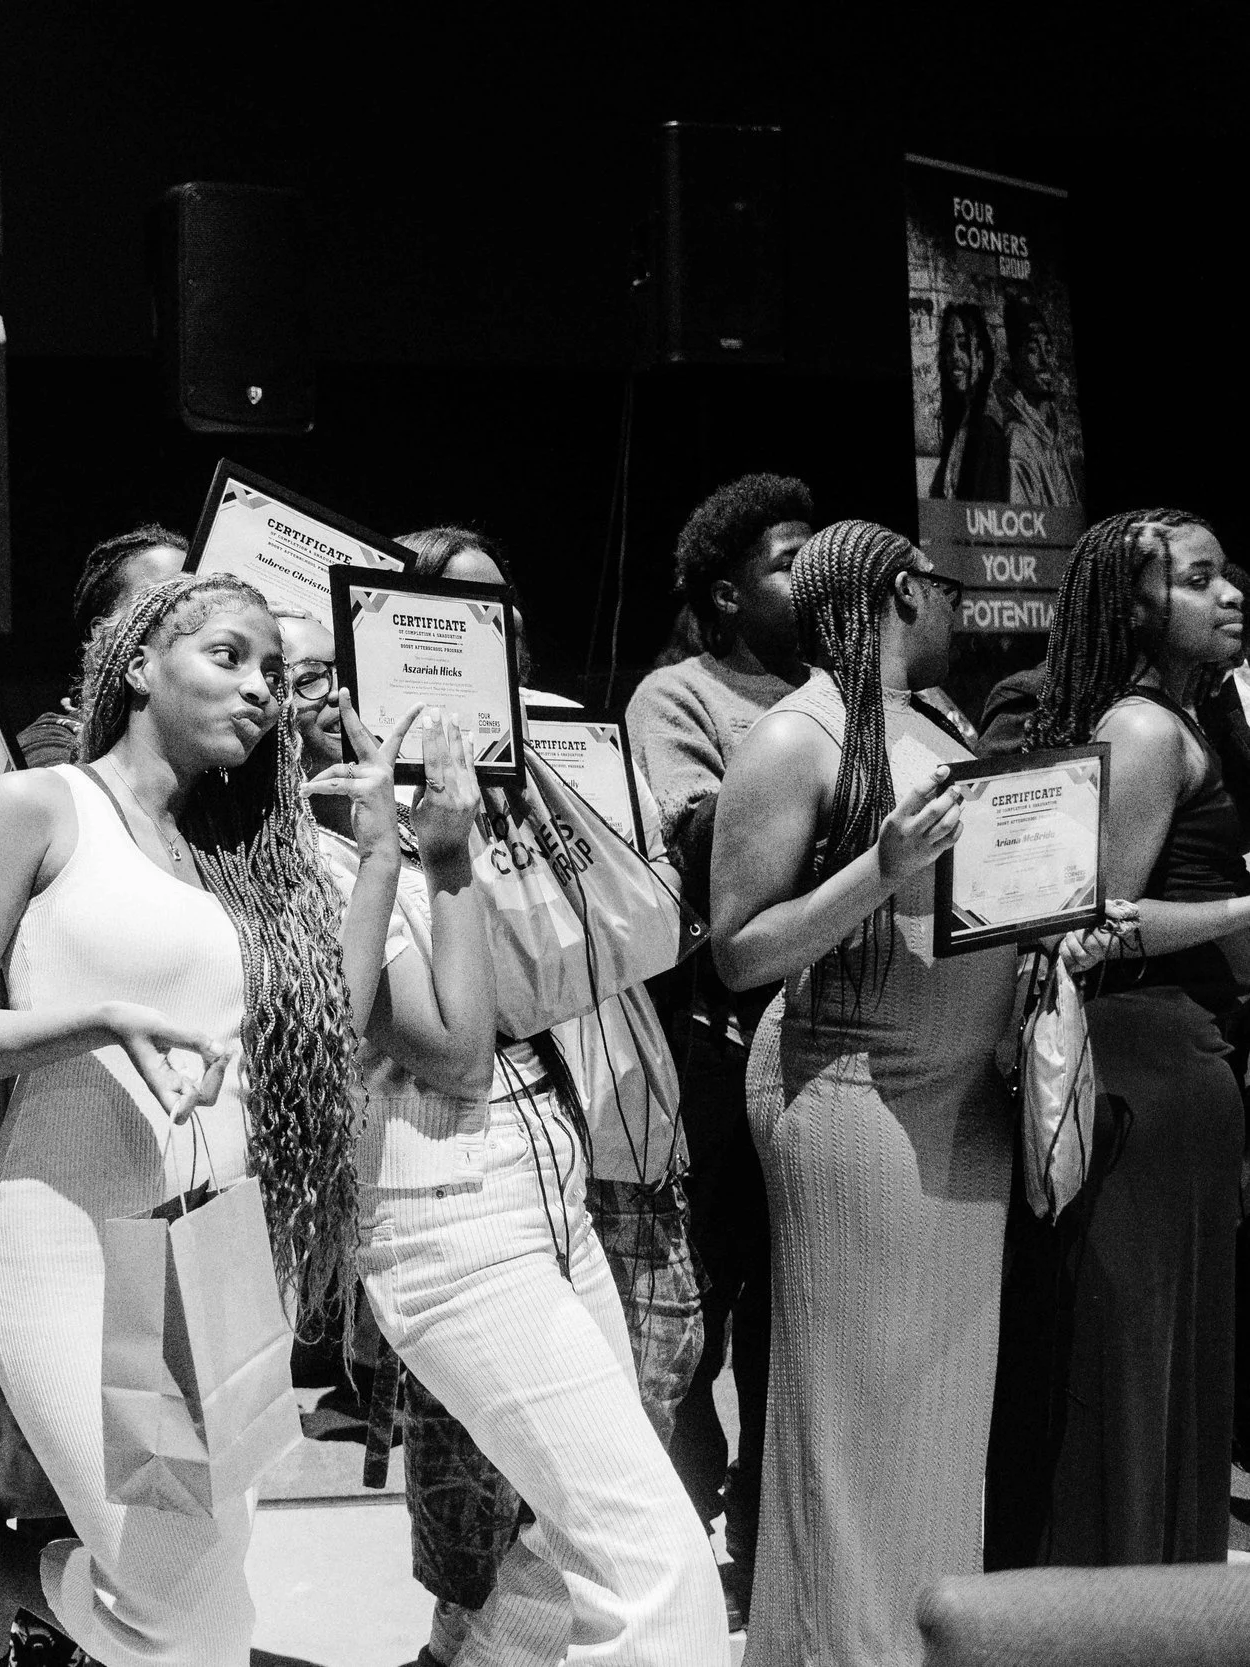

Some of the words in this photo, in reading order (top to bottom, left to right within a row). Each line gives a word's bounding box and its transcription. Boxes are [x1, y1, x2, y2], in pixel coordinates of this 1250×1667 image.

[953, 197, 994, 225] FOUR
[955, 224, 1028, 257] CORNERS
[966, 508, 1047, 539] UNLOCK
[267, 518, 352, 565] CERTIFICATE
[255, 553, 291, 575] Aubree
[292, 570, 331, 594] Christm
[982, 554, 1037, 583] YOUR
[392, 614, 466, 632] CERTIFICATE
[962, 600, 1054, 628] POTENTIA
[402, 663, 439, 675] Aszariah
[440, 666, 463, 677] Hicks
[530, 740, 586, 751] ERTIFICATE
[992, 786, 1062, 807] CERTIFICATE
